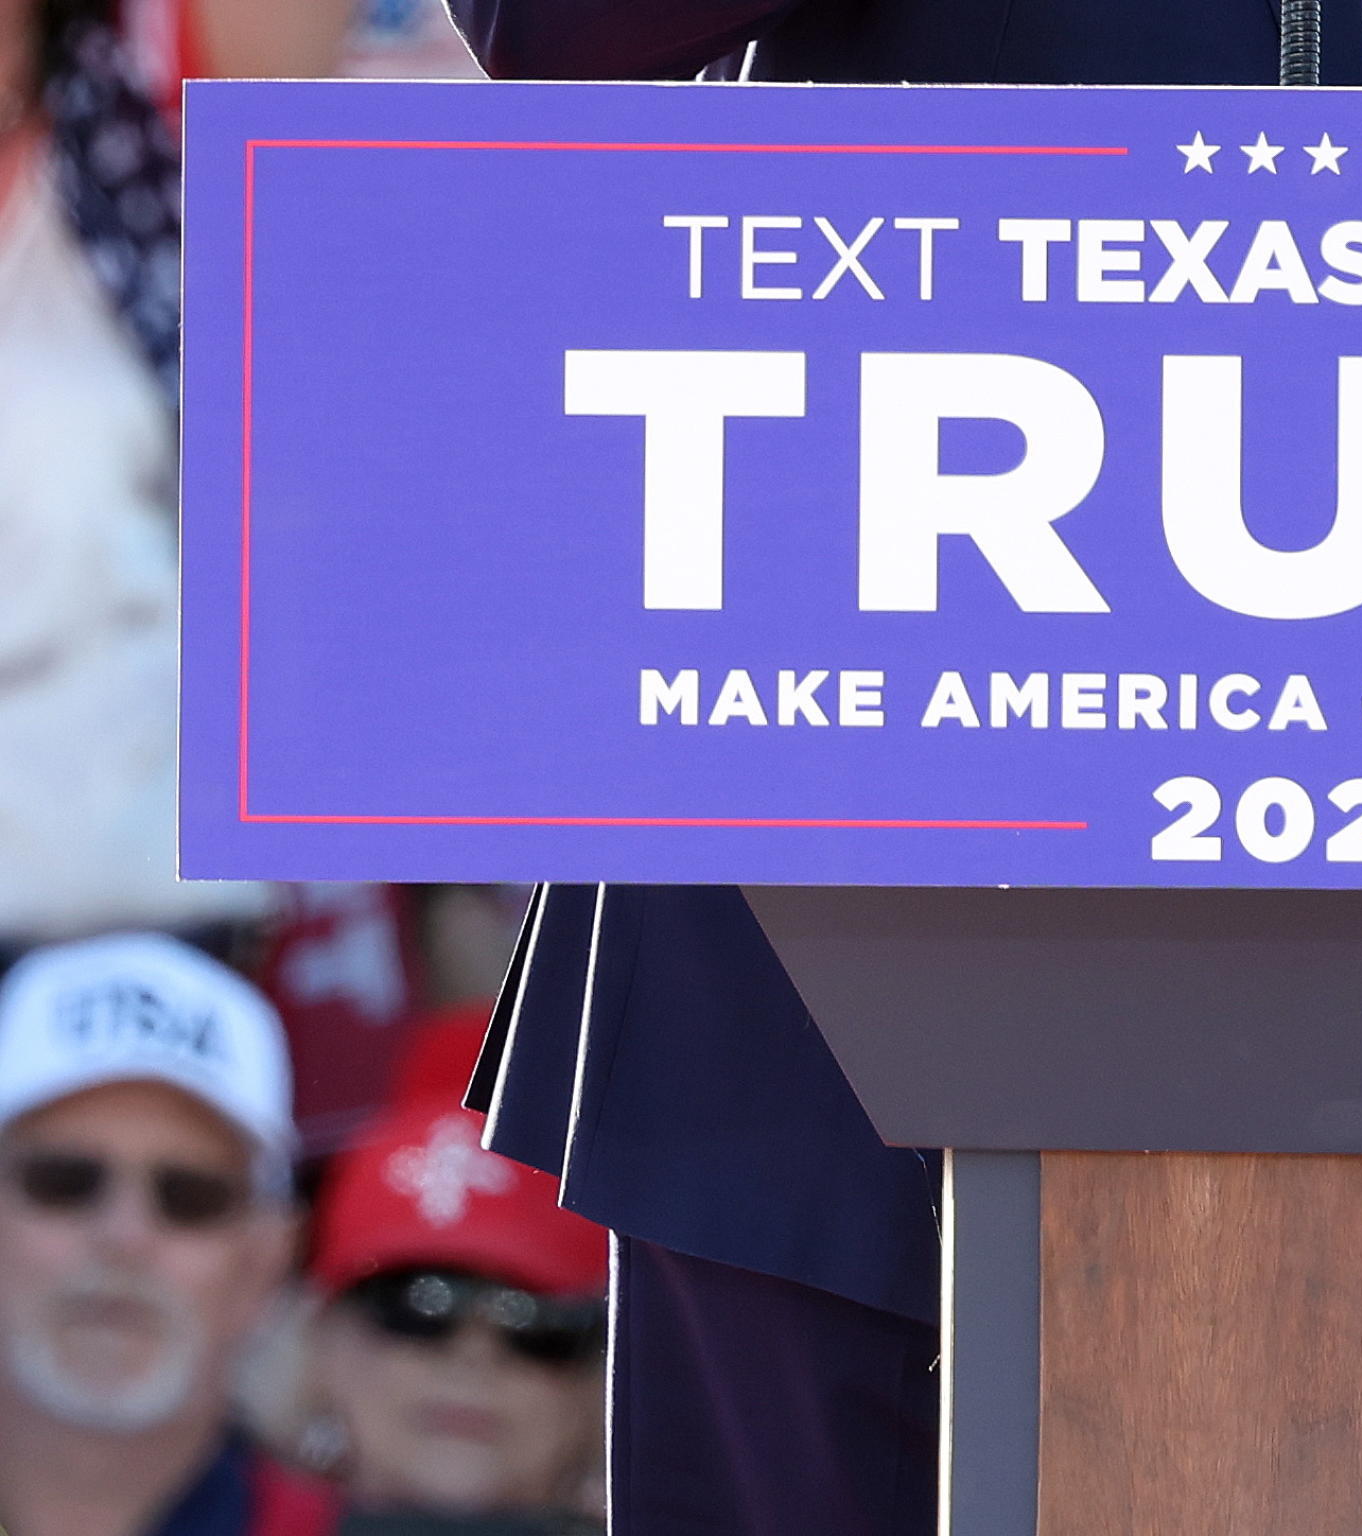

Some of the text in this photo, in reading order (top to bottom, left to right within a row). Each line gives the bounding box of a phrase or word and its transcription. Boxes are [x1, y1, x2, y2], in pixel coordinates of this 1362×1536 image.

[664, 216, 959, 301] TEXT
[639, 669, 885, 727] MAKE
[921, 671, 1328, 731] AMERICA
